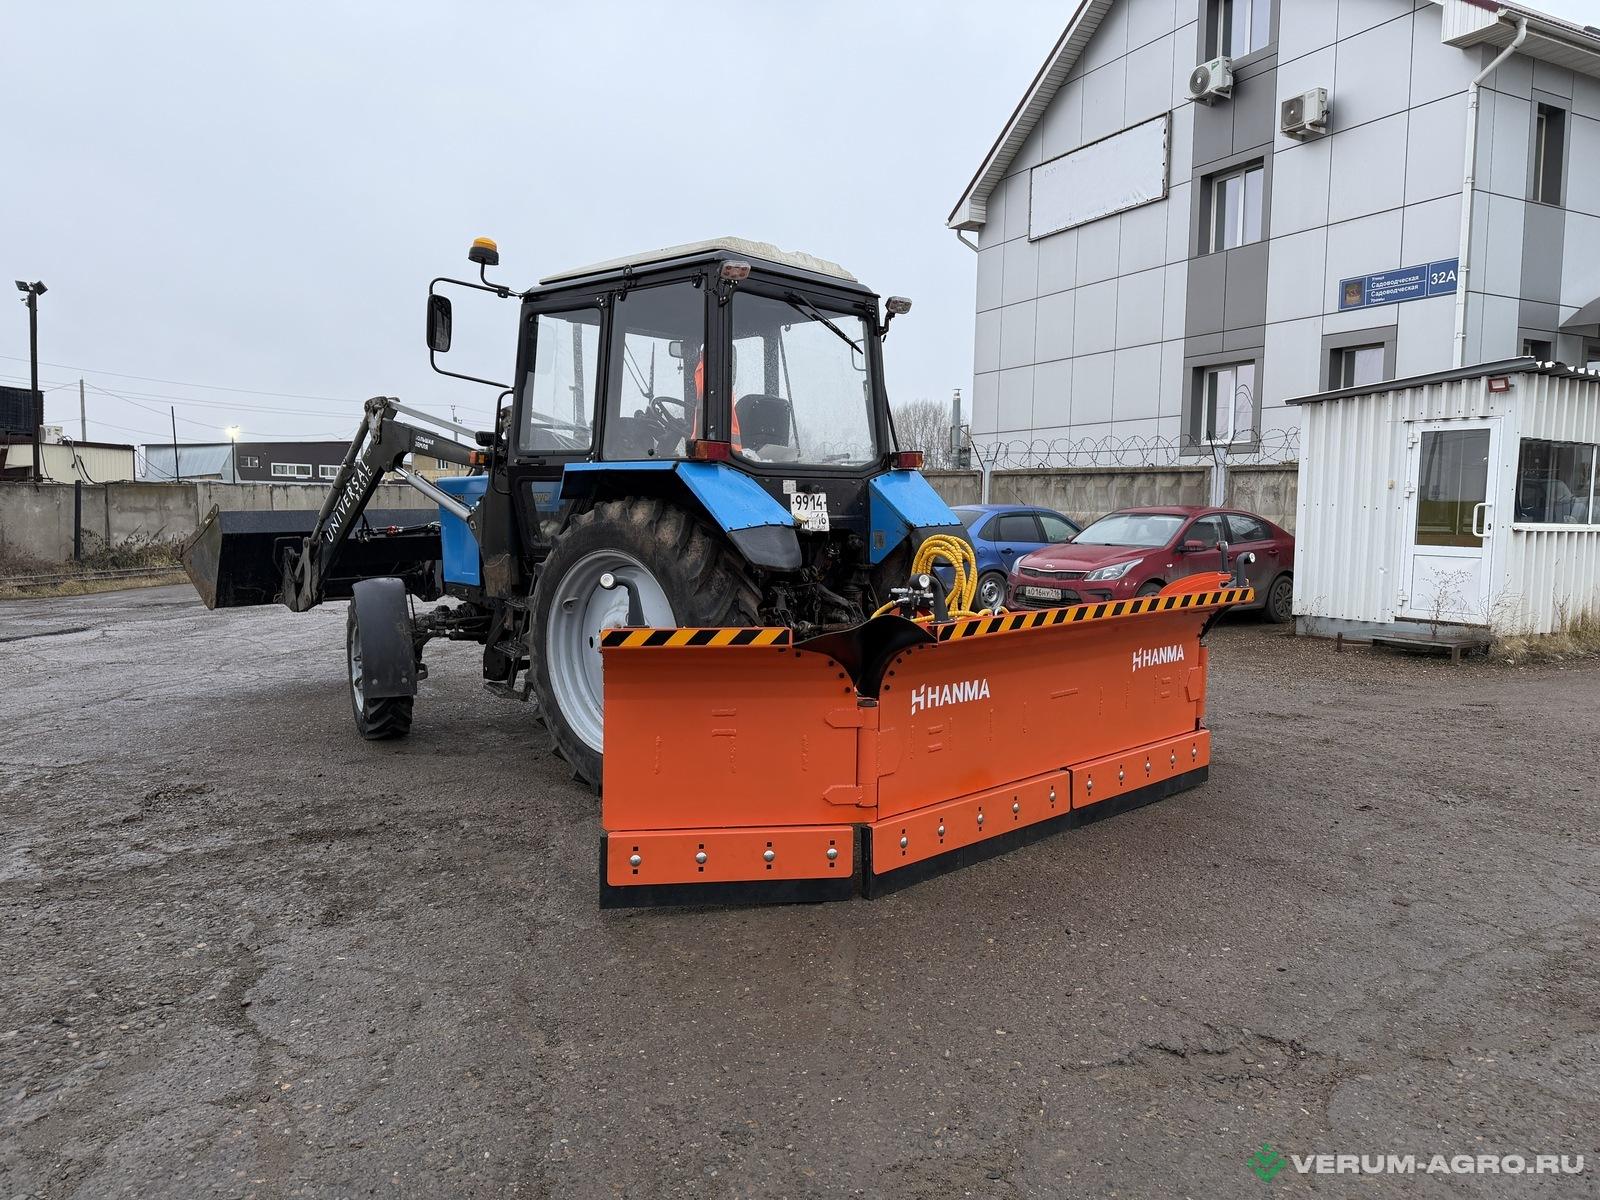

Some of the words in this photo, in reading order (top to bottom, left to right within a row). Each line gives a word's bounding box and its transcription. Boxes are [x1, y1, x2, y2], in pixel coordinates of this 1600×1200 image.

[1370, 285, 1419, 297] Садоводческая
[1371, 276, 1419, 289] Садоводческая
[326, 460, 371, 542] UNIVERSAL
[796, 495, 822, 510] 9914
[1143, 643, 1185, 667] HANMA
[927, 678, 991, 708] HANMA
